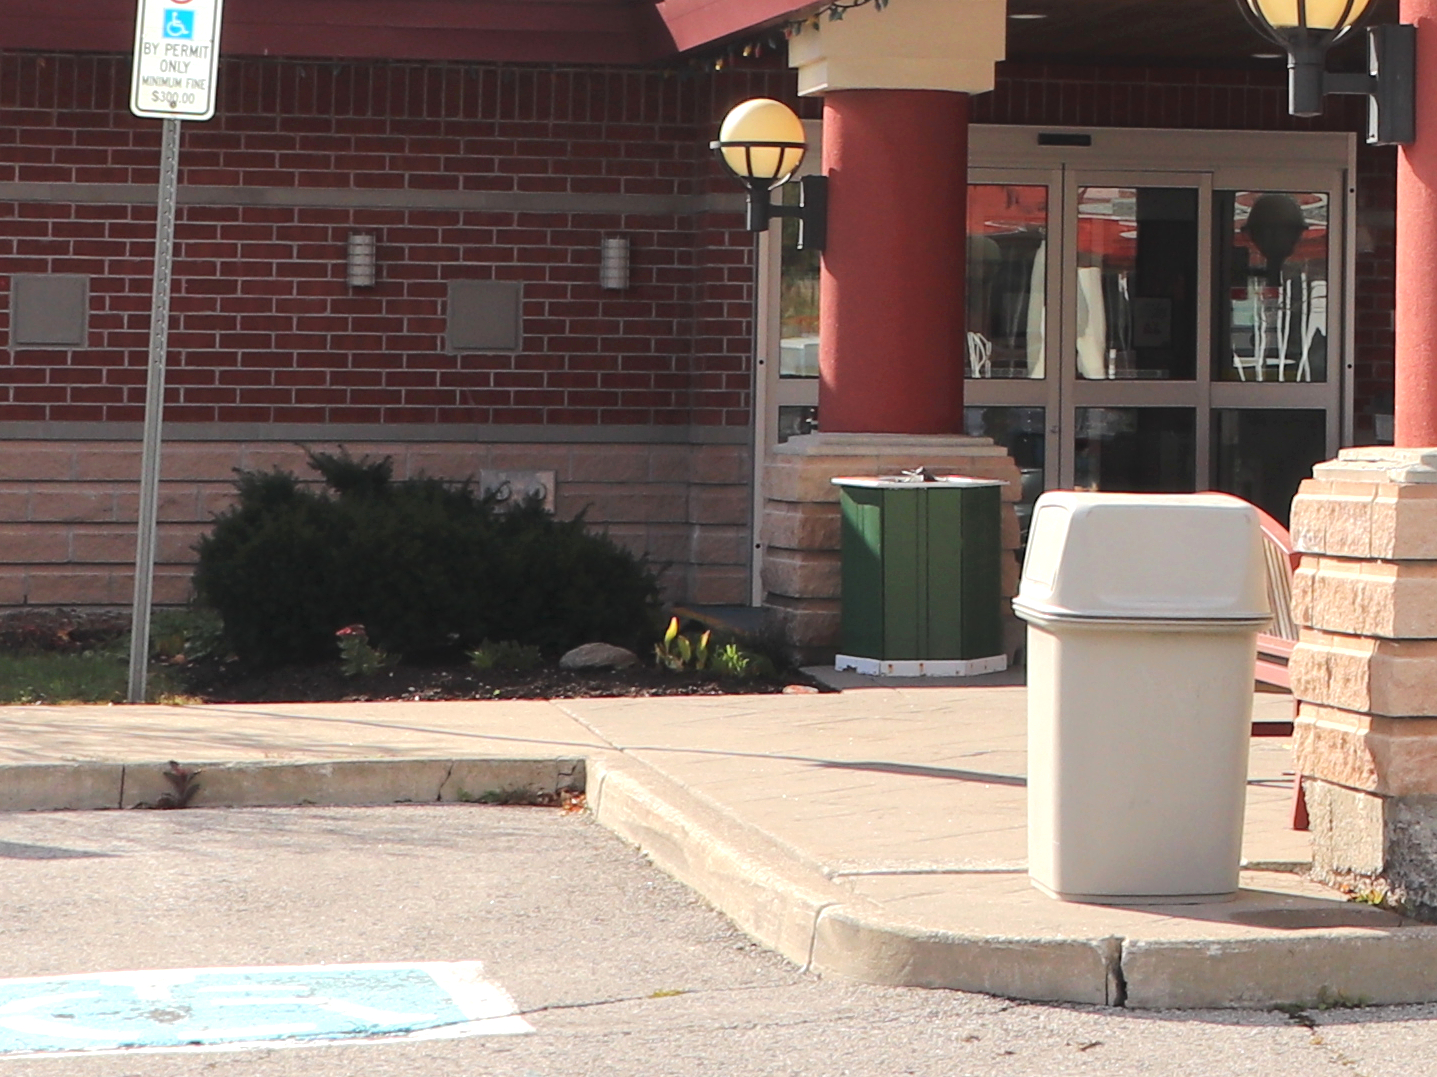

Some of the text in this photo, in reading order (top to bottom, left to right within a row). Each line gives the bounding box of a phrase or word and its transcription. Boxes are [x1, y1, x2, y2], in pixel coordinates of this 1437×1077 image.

[144, 42, 210, 59] BY PERMIT
[160, 60, 191, 74] ONLY
[142, 76, 206, 91] MINIMUM FINE
[152, 90, 195, 104] $300.00
